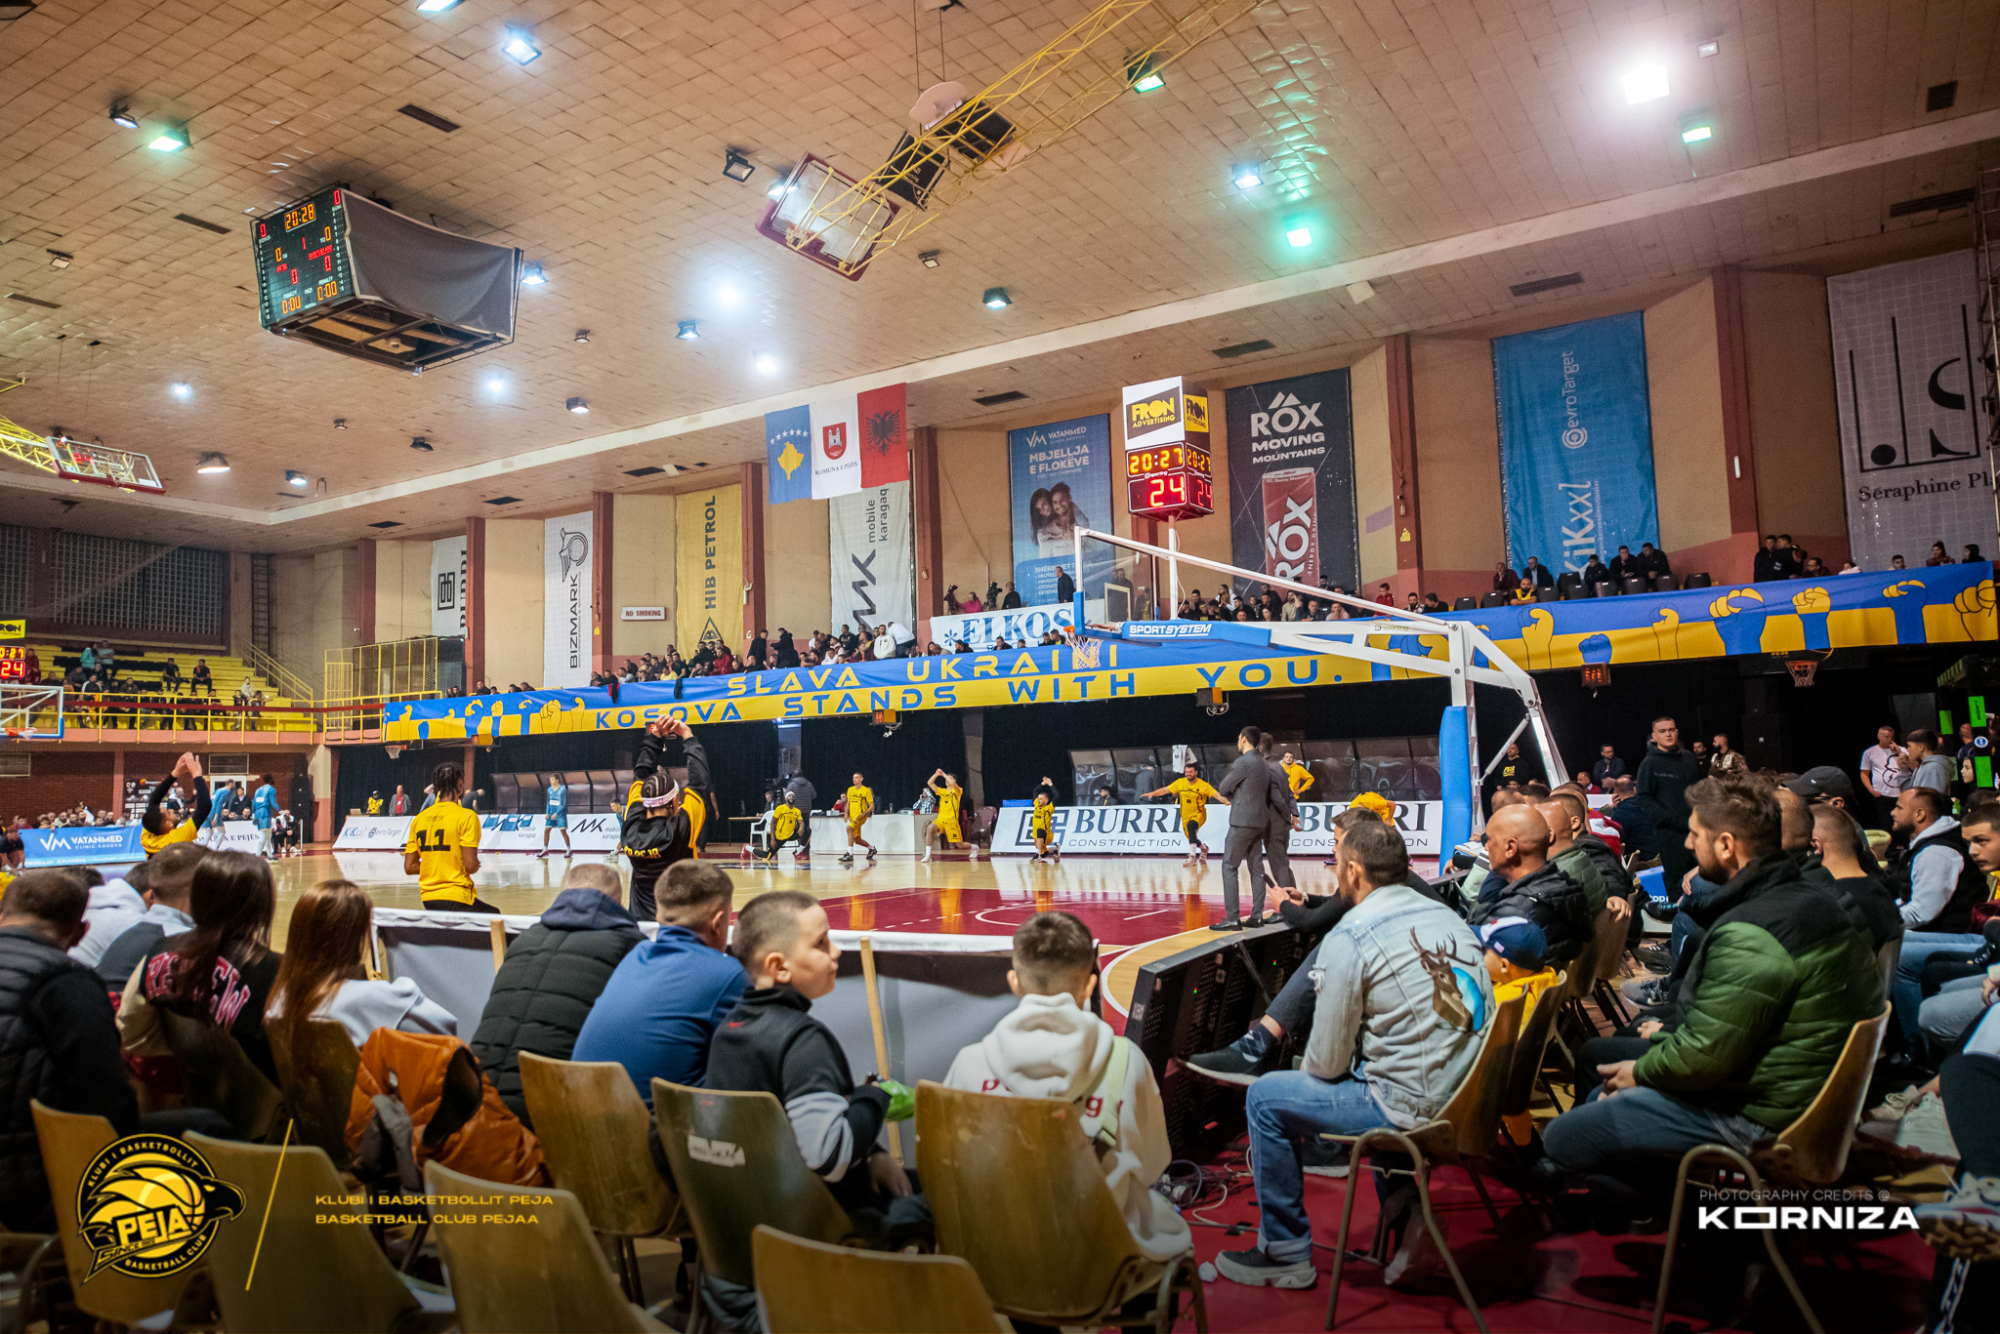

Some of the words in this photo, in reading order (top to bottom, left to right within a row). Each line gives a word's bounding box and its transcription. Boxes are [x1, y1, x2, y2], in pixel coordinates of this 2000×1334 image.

[285, 202, 316, 231] 20:28
[1132, 397, 1175, 421] FRON
[1132, 415, 1175, 428] ADVERTISING
[1186, 397, 1206, 421] FRON
[1251, 402, 1324, 437] ROX
[1048, 426, 1087, 439] VATANMED
[1252, 432, 1325, 452] MOVING
[1029, 444, 1089, 463] MBJELLJA
[1030, 465, 1037, 474] E
[1039, 455, 1090, 473] FLOKËVE
[1129, 447, 1184, 474] 20:27
[1187, 448, 1211, 472] 20:27
[1252, 447, 1326, 464] MOUNTAINS
[1150, 476, 1186, 507] 24
[1197, 479, 1213, 509] 24
[1858, 478, 1962, 501] Séraphine
[866, 499, 877, 543] mobile
[878, 488, 890, 542] karagaq
[705, 495, 717, 570] PETROL
[705, 576, 717, 609] HIB
[570, 574, 578, 669] BIZMARK
[961, 608, 1074, 645] ELKOS
[1, 661, 24, 678] 24
[728, 667, 861, 697] SLAVA
[906, 644, 1118, 682] UKRAINI
[596, 701, 743, 730] KOSOVA
[784, 685, 957, 717] STANDS
[1007, 673, 1136, 703] WITH
[1196, 659, 1343, 689] YOU.
[1072, 807, 1183, 834] BURRI
[71, 835, 123, 844] VATANMED
[416, 828, 451, 852] 11
[1068, 838, 1182, 847] CONSTRUCTION
